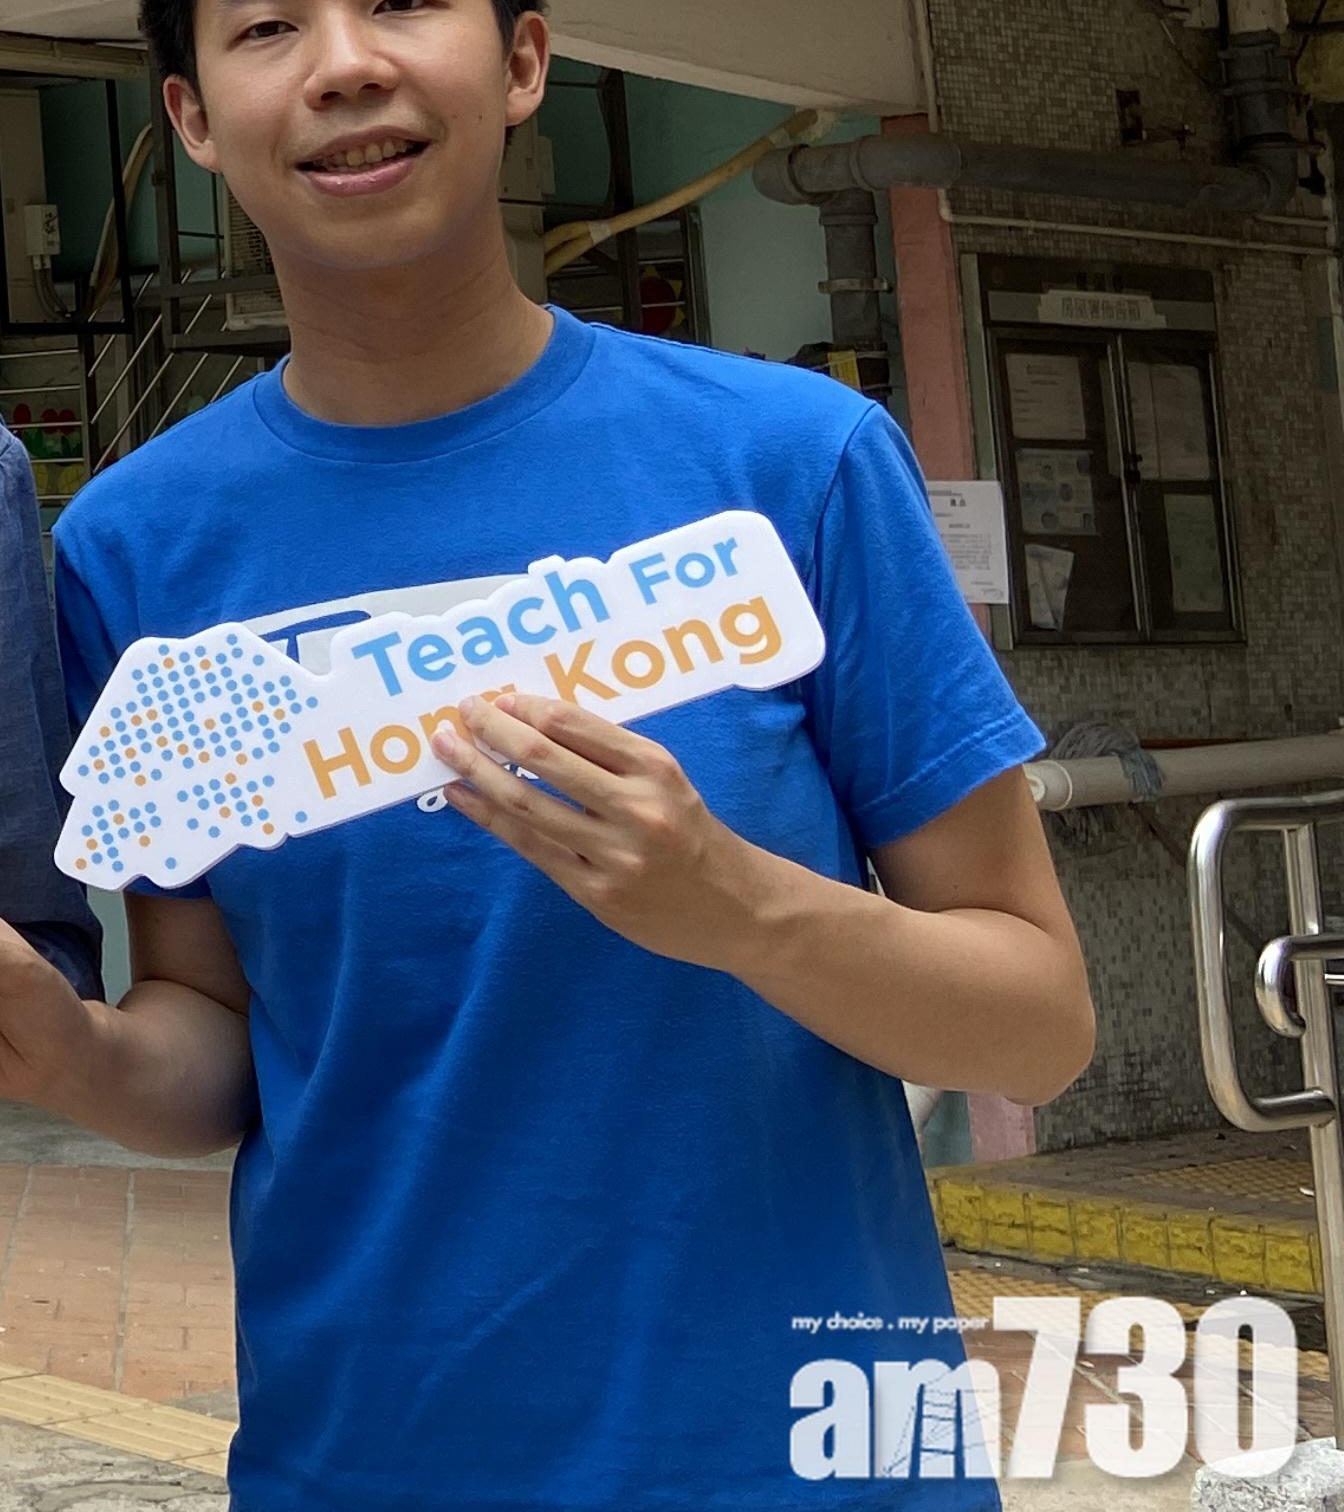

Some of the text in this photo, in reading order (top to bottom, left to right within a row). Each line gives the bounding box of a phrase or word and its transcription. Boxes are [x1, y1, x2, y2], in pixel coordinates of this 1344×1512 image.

[303, 595, 783, 800] Hon Kong
[351, 536, 739, 697] Teach For
